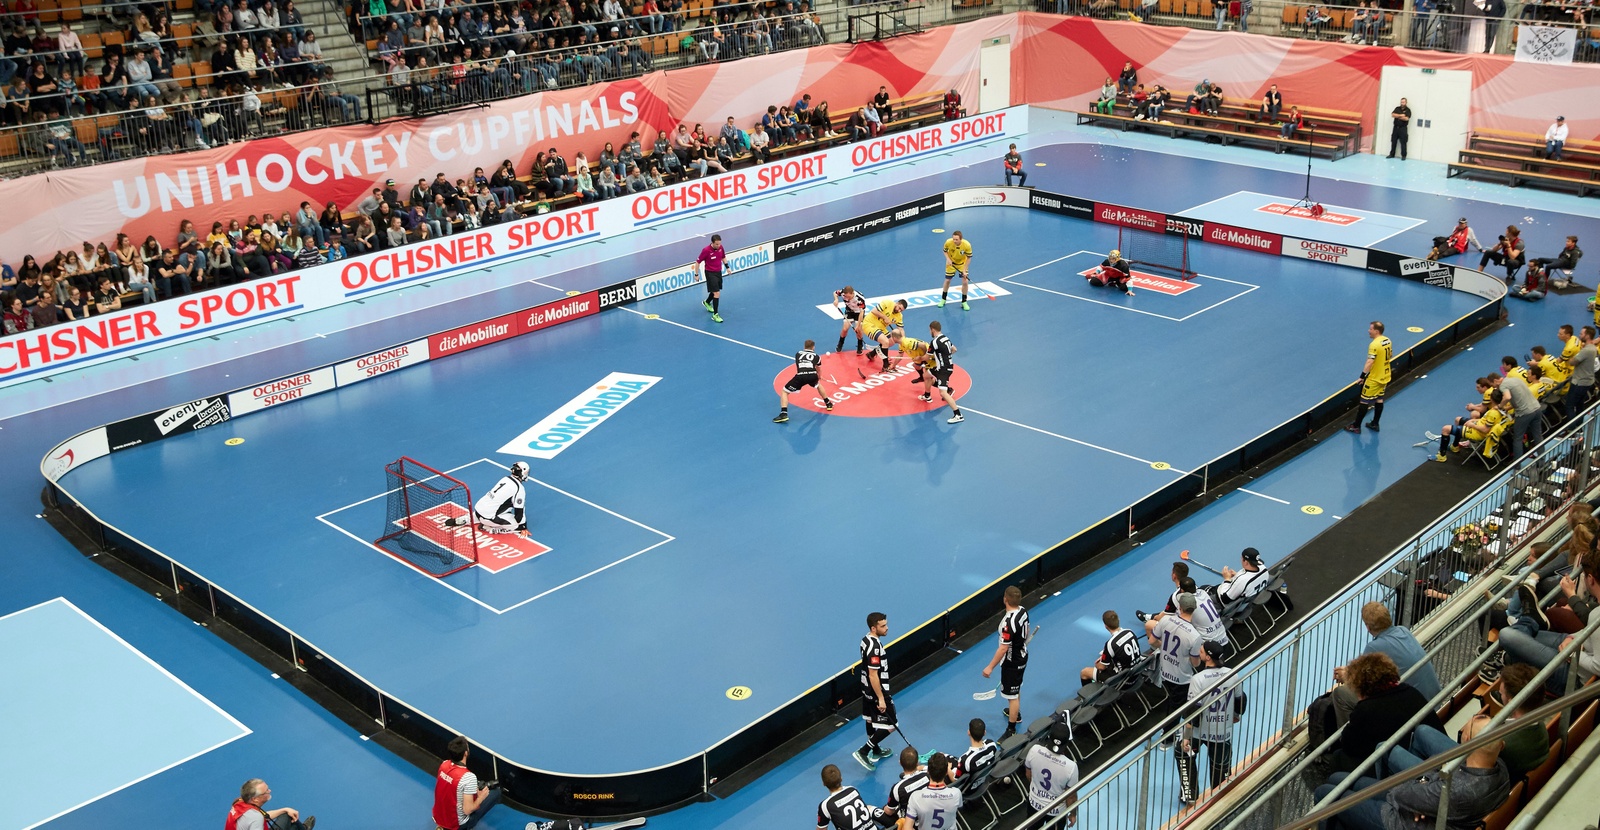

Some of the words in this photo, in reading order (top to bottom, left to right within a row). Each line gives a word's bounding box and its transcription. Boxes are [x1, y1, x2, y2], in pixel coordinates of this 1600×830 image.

[851, 129, 943, 168] OCHSNER
[950, 112, 1007, 144] SPORT
[112, 131, 412, 218] UNIHOCKEY
[428, 91, 639, 161] CUPFINALS
[632, 173, 748, 221] OCHSNER
[757, 153, 828, 190] SPORT
[895, 206, 919, 221] FELSENAU
[1032, 195, 1060, 209] FELSENAU
[777, 239, 803, 253] FAT
[804, 231, 834, 246] PIPE
[839, 223, 863, 236] FAT
[864, 215, 891, 229] PIPE
[1166, 218, 1204, 237] BERN
[340, 231, 495, 290] OCHSNER
[507, 206, 600, 251] SPORT
[1301, 240, 1348, 255] OCHSNER
[1307, 251, 1339, 263] SPORT
[722, 246, 769, 274] NCORDIA
[1131, 275, 1182, 291] obiliar
[178, 275, 301, 330] SPORT
[599, 284, 637, 307] BERN
[356, 345, 409, 368] OCHSNER
[366, 358, 402, 377] SPORT
[253, 374, 311, 399] OCHSNER
[264, 387, 303, 407] SPORT
[527, 379, 650, 452] CONCORDIA
[493, 482, 506, 493] 1
[1124, 638, 1140, 662] 94
[1162, 629, 1181, 658] 12
[1039, 768, 1052, 792] 3
[843, 798, 870, 829] 23
[931, 808, 945, 829] 5
